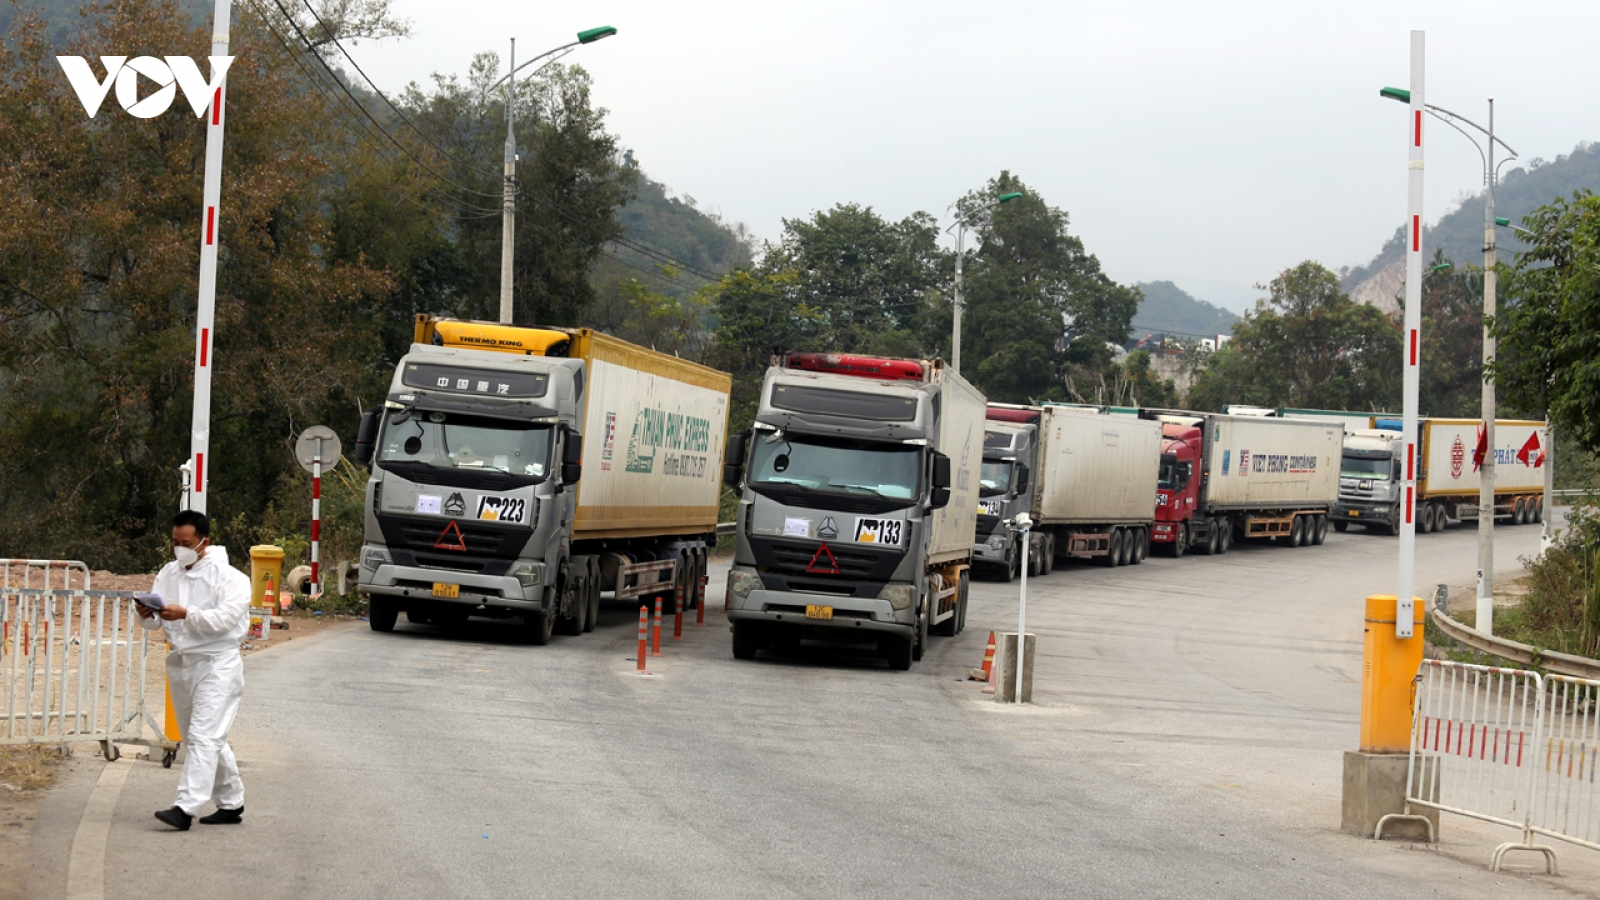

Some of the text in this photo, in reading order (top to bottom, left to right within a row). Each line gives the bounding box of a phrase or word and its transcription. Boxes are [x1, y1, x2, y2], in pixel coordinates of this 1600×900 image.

[460, 336, 523, 347] THERMO KING
[683, 415, 710, 453] EXPRESS
[499, 497, 525, 522] 223
[879, 520, 901, 544] 133
